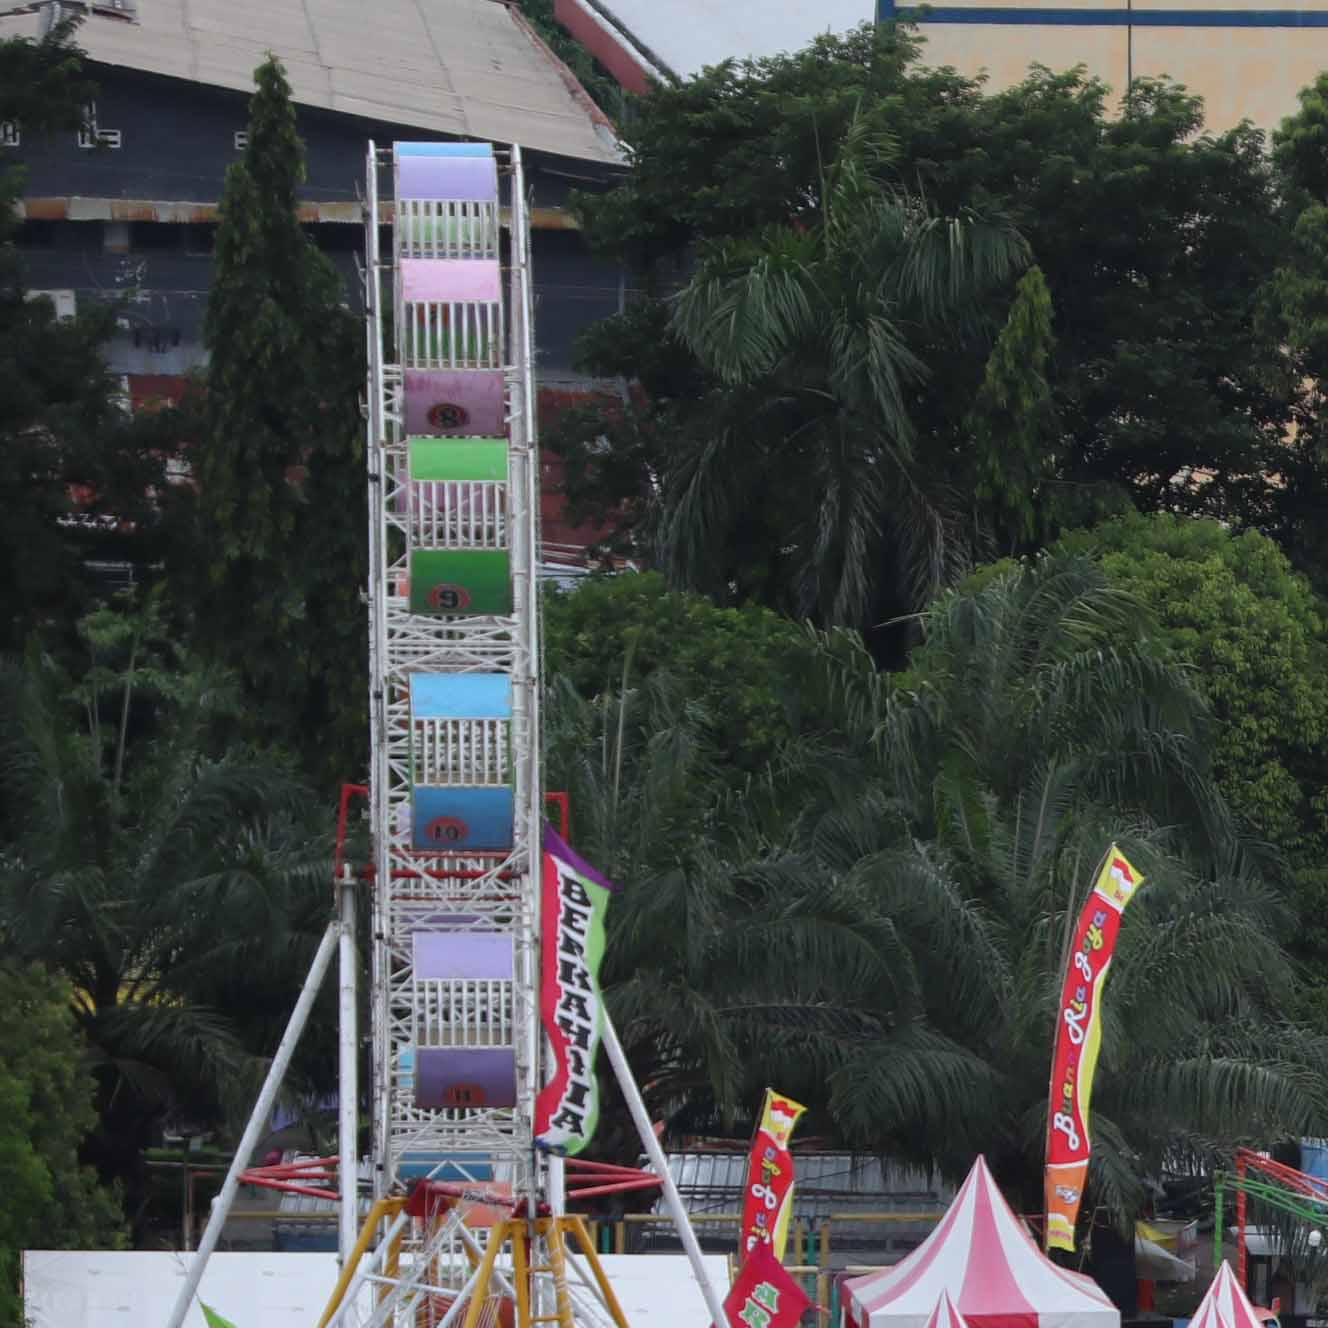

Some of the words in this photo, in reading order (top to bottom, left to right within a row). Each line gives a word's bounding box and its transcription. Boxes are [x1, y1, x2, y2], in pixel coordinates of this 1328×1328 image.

[440, 590, 459, 609] 9
[1074, 909, 1104, 983] Jaya
[1063, 985, 1087, 1045] Ria
[1053, 1052, 1081, 1152] Buana
